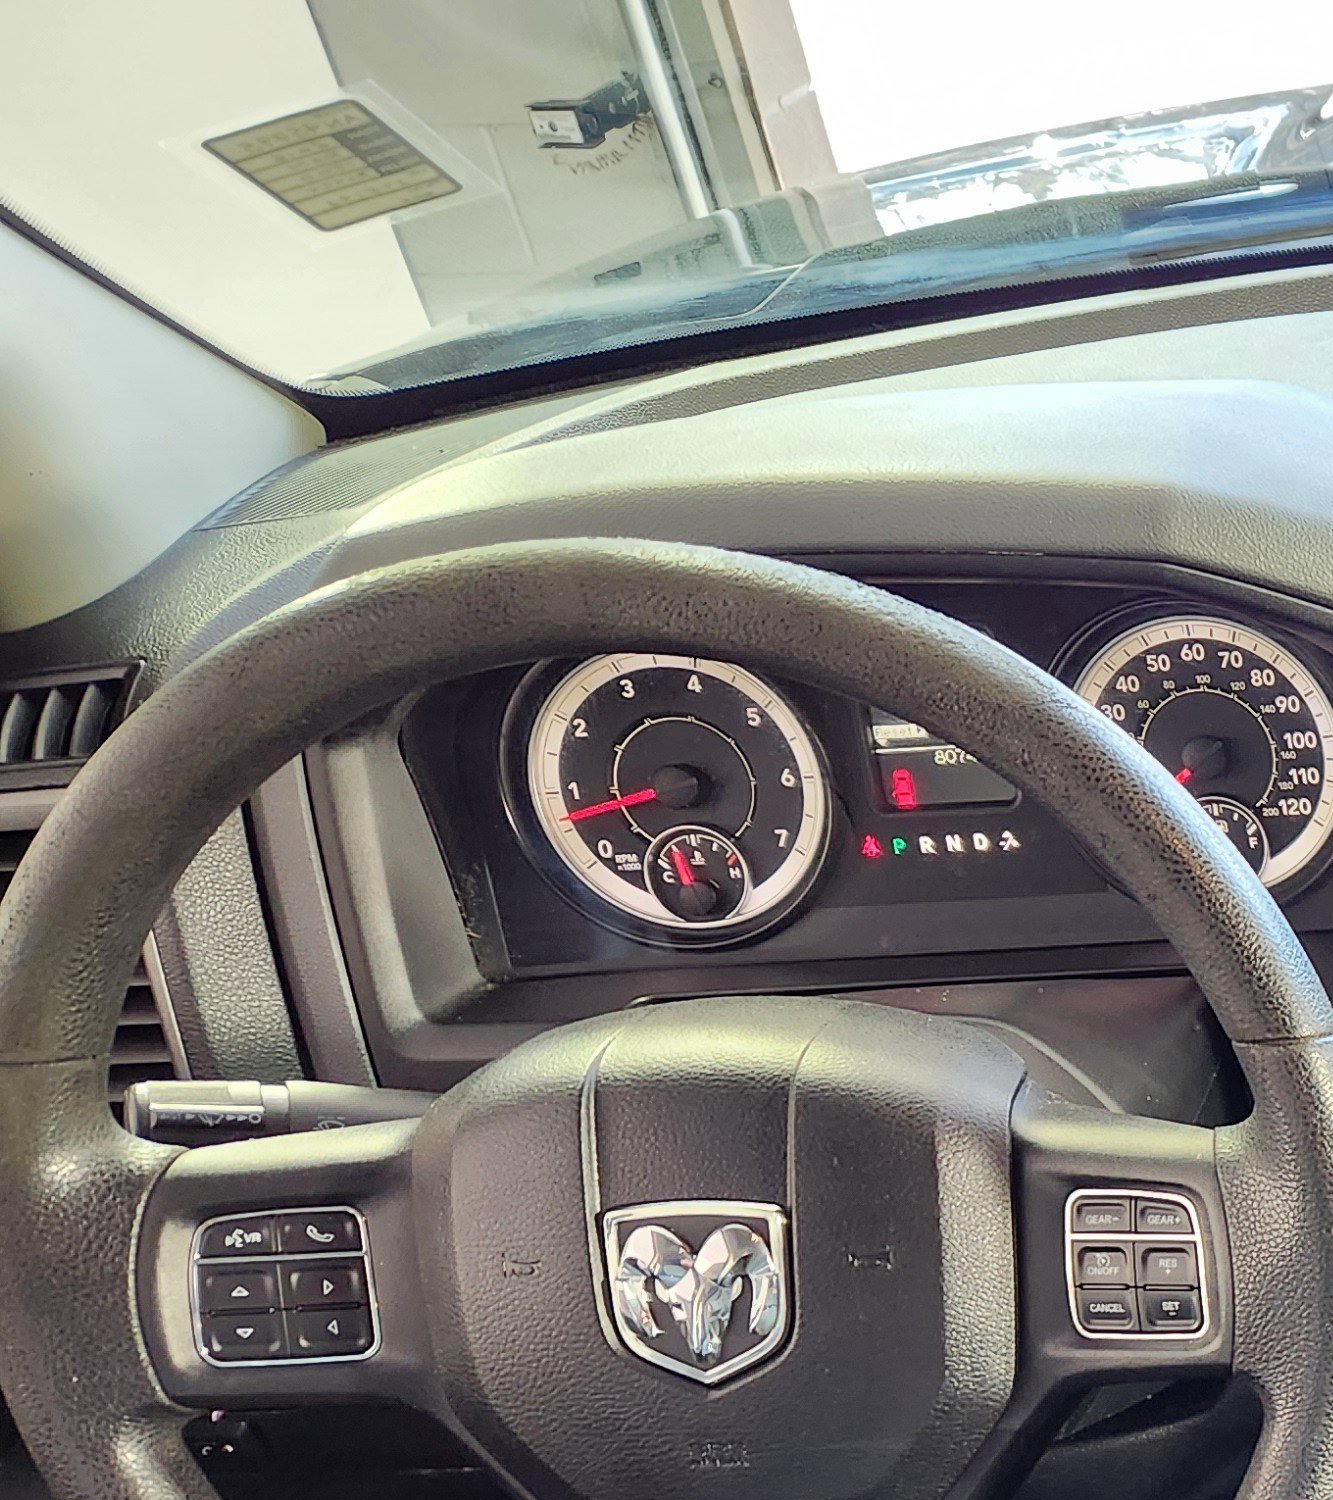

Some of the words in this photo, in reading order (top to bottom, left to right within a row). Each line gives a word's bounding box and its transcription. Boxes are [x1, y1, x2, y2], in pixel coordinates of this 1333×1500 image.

[1180, 643, 1206, 662] 60
[1217, 650, 1243, 670] 70
[1146, 653, 1171, 672] 50
[687, 674, 702, 694] 4
[1115, 674, 1140, 693] 40
[1163, 680, 1176, 690] 80
[1195, 674, 1211, 685] 100
[1229, 681, 1246, 691] 120
[1250, 668, 1275, 688] 80
[619, 678, 635, 699] 3
[1100, 704, 1126, 723] 30
[1137, 699, 1150, 709] 60
[1259, 704, 1277, 714] 140
[1274, 695, 1301, 714] 90
[745, 707, 762, 727] 5
[572, 718, 589, 738] 2
[1282, 731, 1317, 750] 100
[780, 768, 796, 788] 6
[1288, 766, 1320, 785] 110
[567, 781, 581, 800] 1
[1262, 807, 1280, 817] 200
[1278, 797, 1312, 816] 120
[773, 829, 790, 848] 7
[892, 837, 907, 855] P
[918, 835, 938, 855] R
[944, 834, 964, 853] N
[972, 833, 989, 851] D
[1249, 836, 1259, 849] F
[597, 839, 613, 859] 0
[729, 867, 742, 879] H
[1158, 1258, 1178, 1268] RES
[1089, 1303, 1126, 1314] CANCEL
[1162, 1301, 1180, 1311] SET
